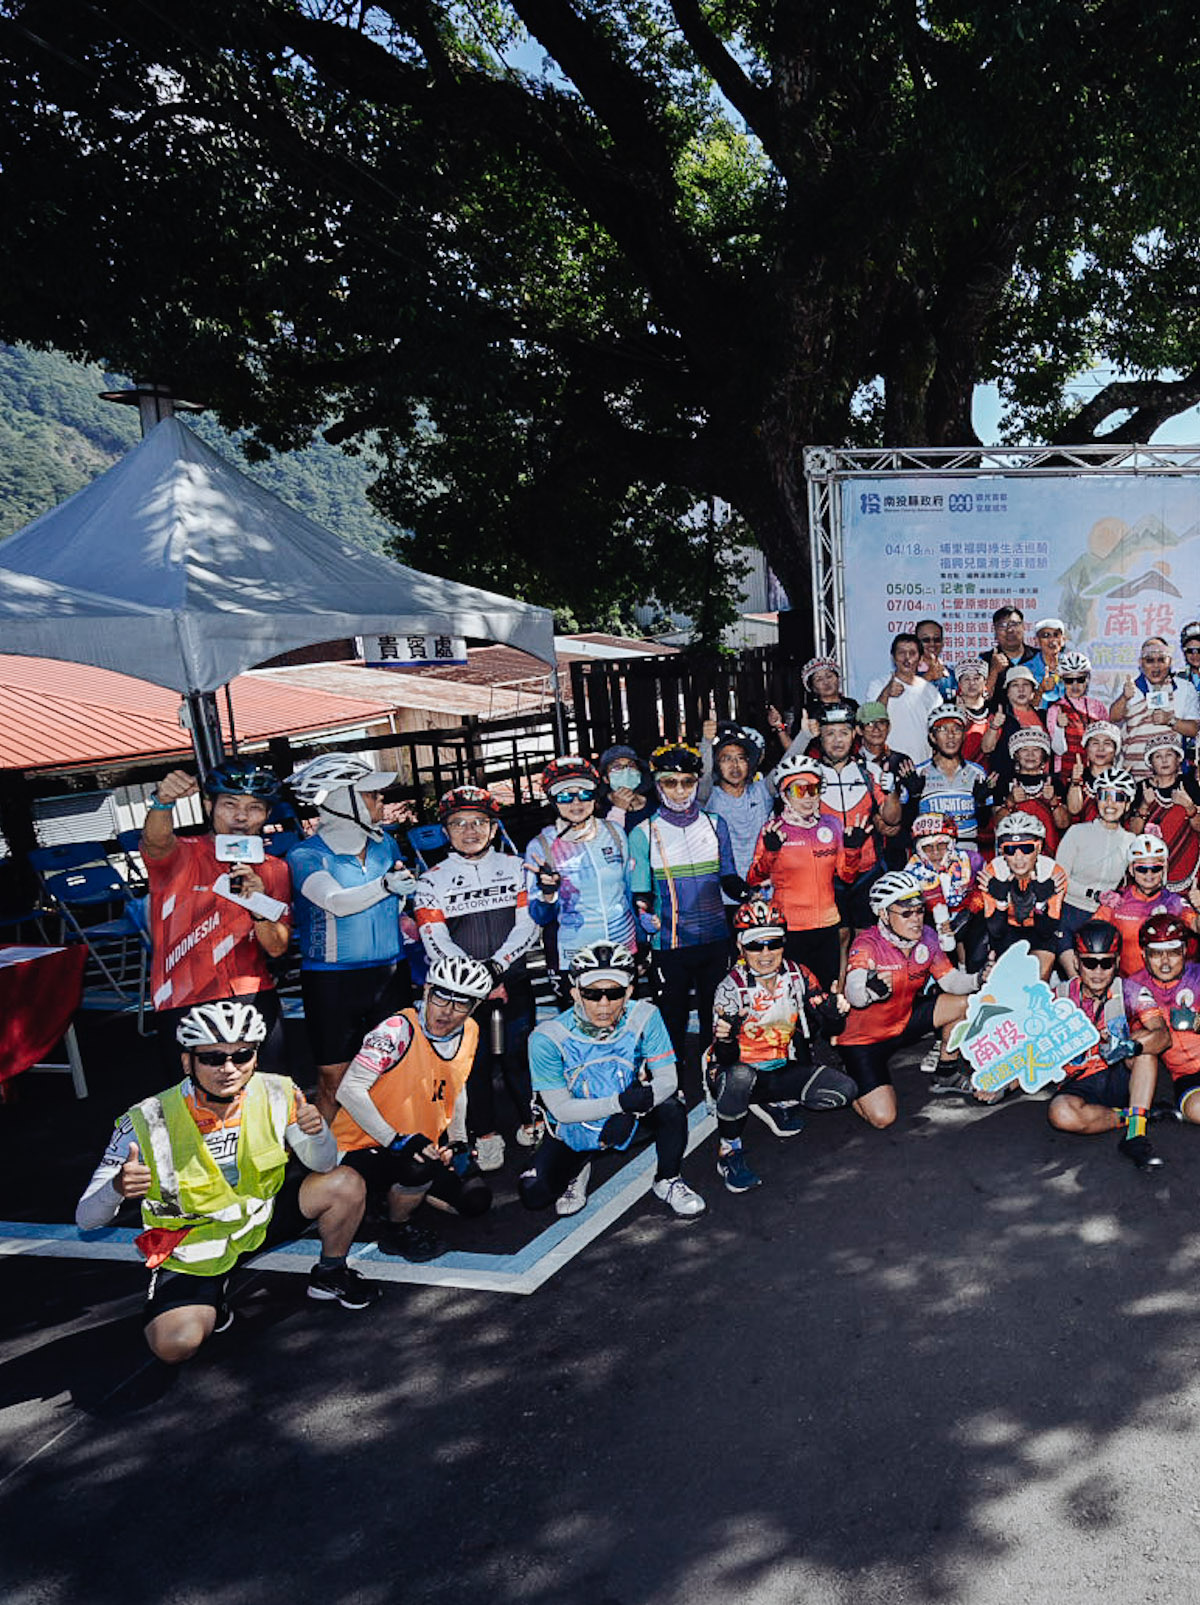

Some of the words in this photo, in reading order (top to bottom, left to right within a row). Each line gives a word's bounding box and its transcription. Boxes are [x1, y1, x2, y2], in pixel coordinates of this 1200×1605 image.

[883, 494, 944, 507] 南投縣政府
[940, 582, 976, 595] 記者會
[1103, 602, 1177, 637] 南投
[443, 883, 517, 904] TREK
[445, 897, 490, 912] FACTORY
[164, 911, 221, 974] INDONESIA
[968, 1019, 1026, 1067] 南投
